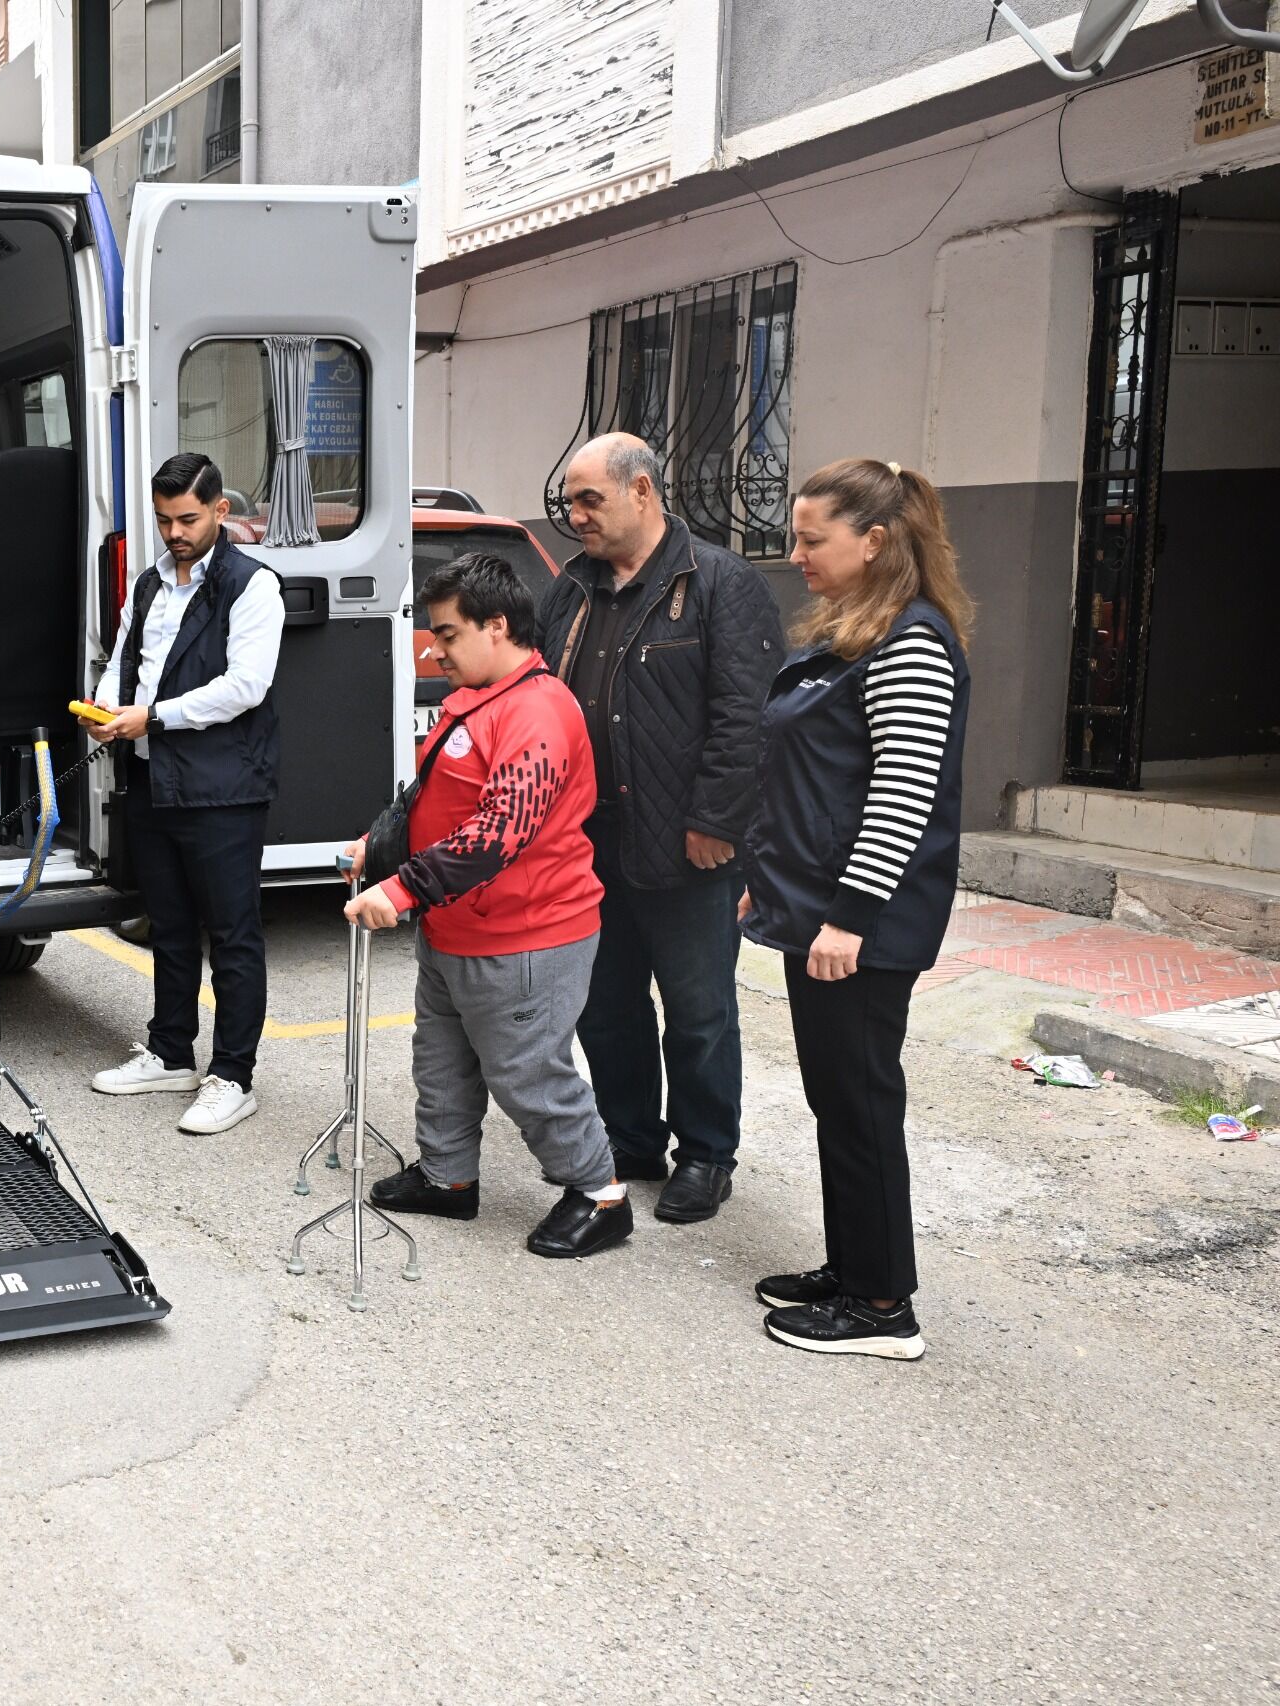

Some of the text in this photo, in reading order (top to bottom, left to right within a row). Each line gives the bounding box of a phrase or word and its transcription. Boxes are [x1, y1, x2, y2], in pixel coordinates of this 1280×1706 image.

[1203, 74, 1247, 100] UHTAR
[311, 424, 327, 433] KAT
[319, 437, 361, 446] UYGULAN
[44, 1280, 101, 1294] SERIES
